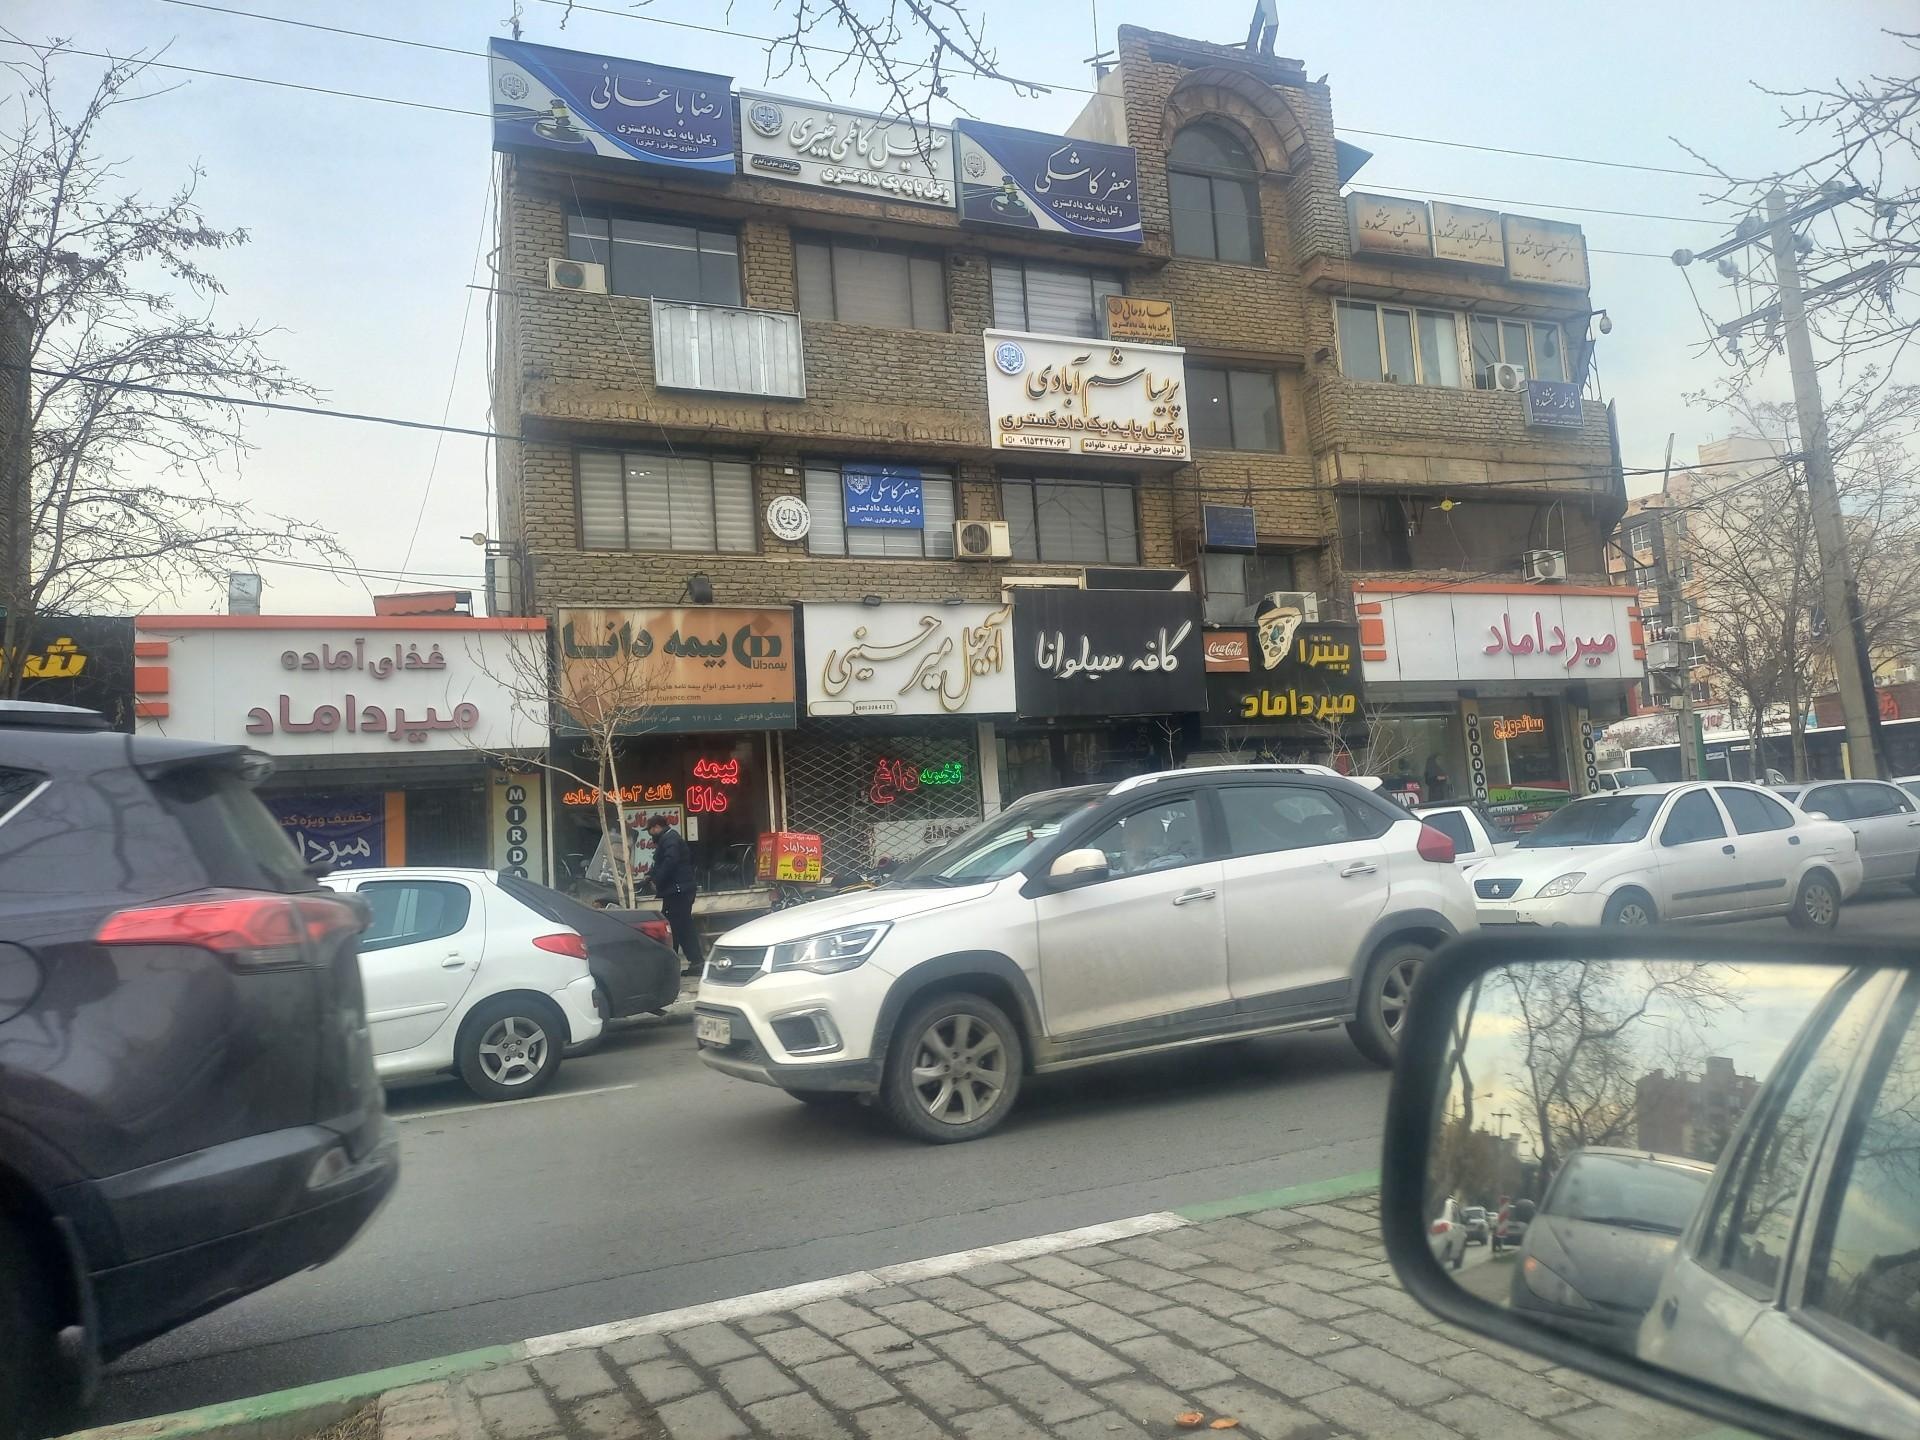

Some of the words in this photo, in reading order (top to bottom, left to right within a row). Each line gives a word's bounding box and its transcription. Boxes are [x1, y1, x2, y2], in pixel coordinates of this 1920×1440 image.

[690, 91, 723, 120] رضا
[616, 122, 661, 136] دادگستری
[662, 128, 677, 139] یک
[679, 131, 694, 145] پایه
[696, 134, 717, 147] وکیل
[829, 118, 879, 163] کاظمی
[869, 127, 948, 173] جلیل
[820, 166, 880, 186] دادگستری
[1034, 142, 1107, 195] کاشکی
[880, 174, 901, 194] یک
[901, 177, 923, 199] پایه
[924, 178, 951, 204] وکیل
[1101, 171, 1132, 201] جعفر
[1052, 199, 1082, 209] دادگستری
[1084, 202, 1094, 212] یک
[1095, 204, 1107, 215] پایه
[1107, 205, 1123, 217] وکیل
[1112, 321, 1137, 329] دادگستری
[1139, 322, 1147, 331] یک
[1147, 323, 1157, 331] پایه
[1157, 323, 1170, 333] وکیل
[1026, 352, 1093, 407] آبادی
[1145, 372, 1181, 418] پریسا
[999, 411, 1085, 431] دادگستری
[1085, 415, 1110, 436] یک
[1112, 418, 1143, 440] پایه
[1143, 420, 1185, 443] وکیل
[1085, 441, 1106, 450] خانواده
[1153, 446, 1171, 455] دعاوی
[1171, 447, 1185, 456] قبول
[896, 482, 920, 503] جعفر
[849, 503, 880, 513] دادگستری
[881, 504, 892, 514] یک
[892, 504, 904, 515] پایه
[905, 505, 921, 515] وکیل
[562, 620, 654, 660] دانا
[663, 628, 728, 669] بیمه
[1129, 619, 1193, 672] کافه
[1208, 640, 1244, 657] Coca-Cola
[1483, 610, 1617, 669] میرداماد
[280, 637, 366, 672] آماده
[368, 641, 447, 680] غذای
[938, 604, 1014, 712] آجیل
[1036, 629, 1124, 680] سیلوانا
[1298, 633, 1350, 675] پیتزا
[1241, 688, 1357, 722] میرداماد
[245, 693, 481, 743] میرداماد
[1493, 714, 1545, 740] ساندویچ
[1467, 713, 1487, 800] MIRDAM
[1582, 723, 1599, 794] MIRDA
[693, 758, 738, 785] بیمه
[869, 758, 920, 804] داغ
[644, 782, 673, 802] ثالث
[686, 785, 728, 813] دانا
[328, 810, 373, 825] تخفیف
[507, 786, 527, 879] MIRDA
[296, 830, 371, 868] میردا
[782, 841, 819, 857] میرداماد
